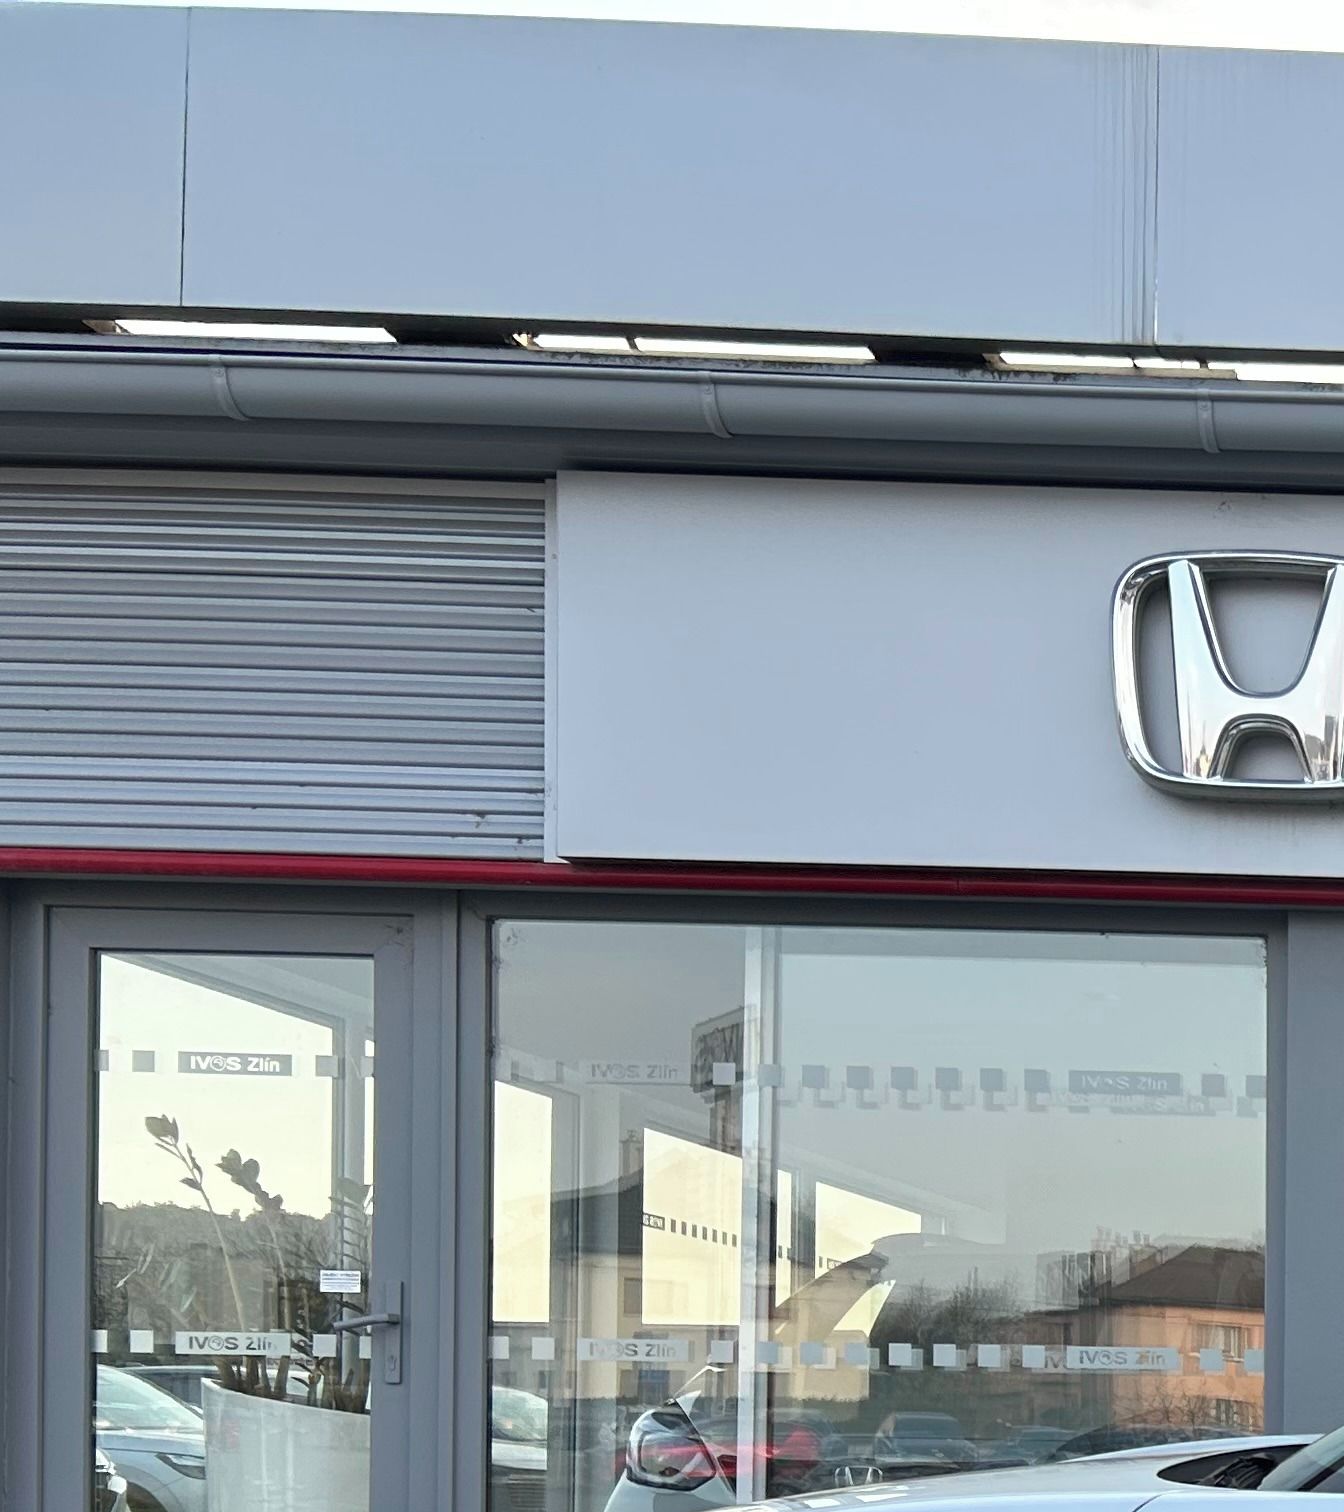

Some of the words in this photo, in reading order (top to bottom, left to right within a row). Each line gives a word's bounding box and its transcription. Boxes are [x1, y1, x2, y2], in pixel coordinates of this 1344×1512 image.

[190, 1055, 242, 1071] IVOS
[247, 1056, 280, 1072] Zlín
[188, 1335, 239, 1351] IVOS
